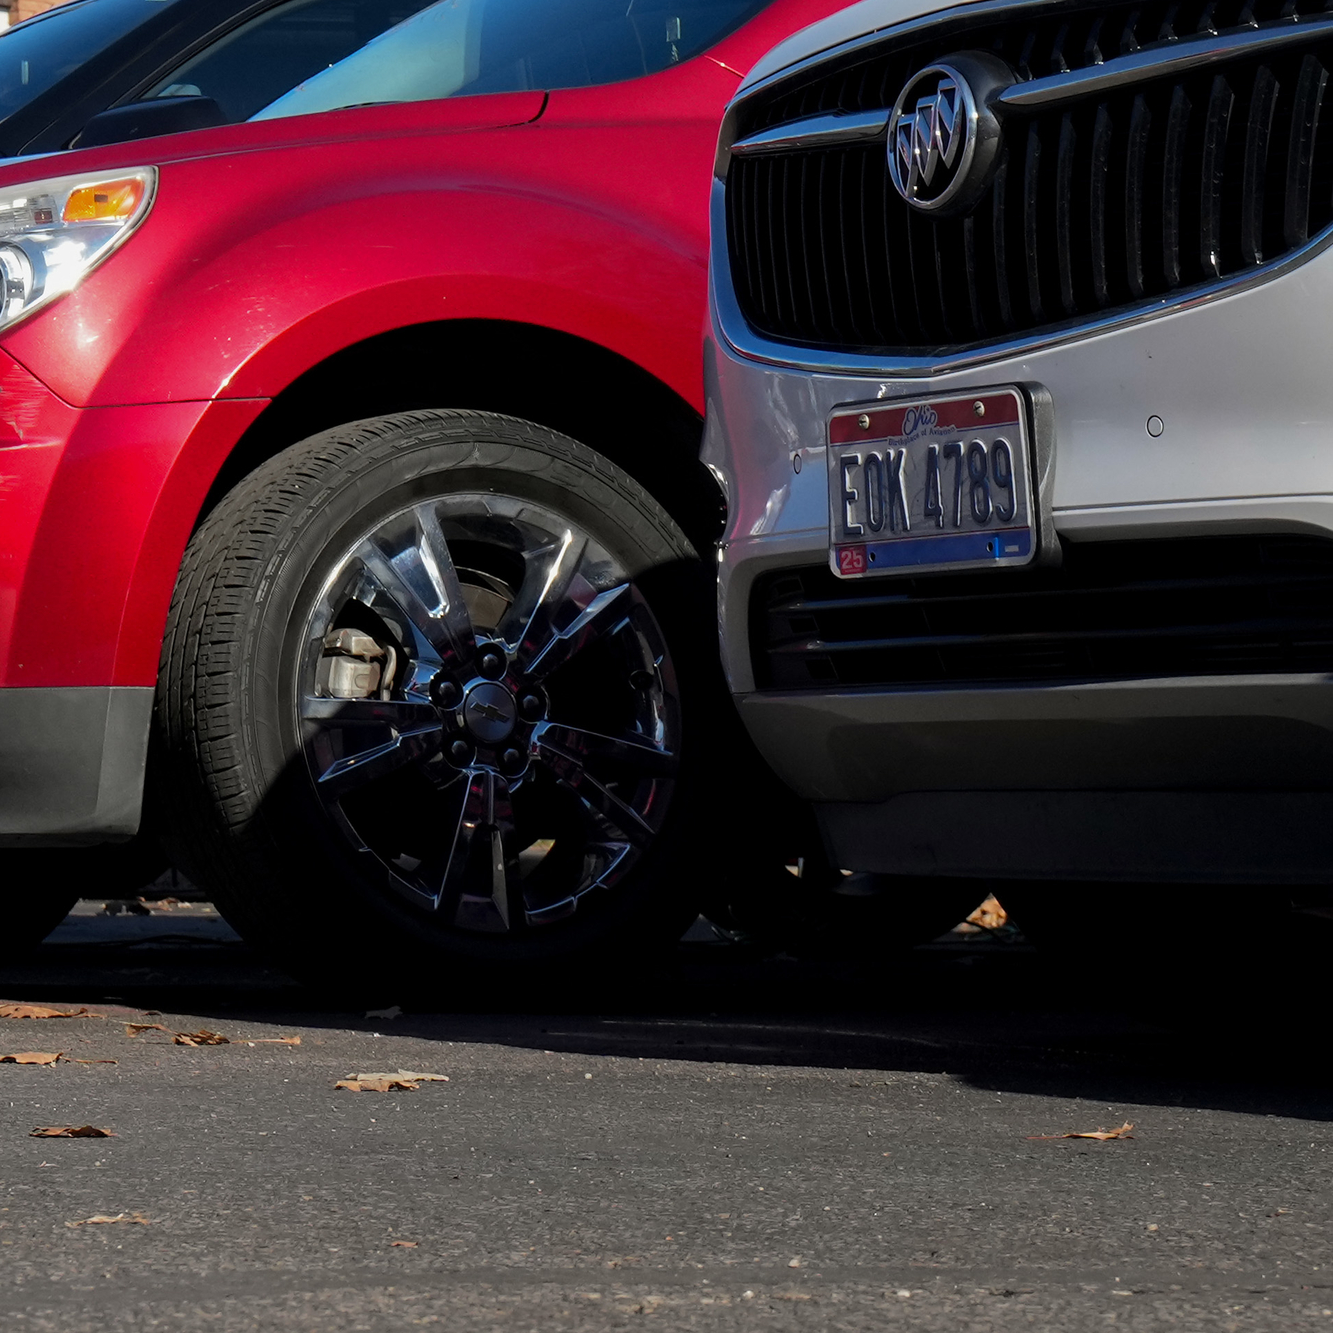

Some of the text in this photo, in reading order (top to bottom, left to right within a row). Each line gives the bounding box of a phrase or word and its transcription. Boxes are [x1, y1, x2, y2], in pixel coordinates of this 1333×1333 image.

[903, 405, 938, 436] Ohio
[888, 431, 920, 446] Birthplace
[929, 426, 956, 436] Aviation
[924, 437, 1018, 529] 4789
[841, 551, 864, 570] 25
